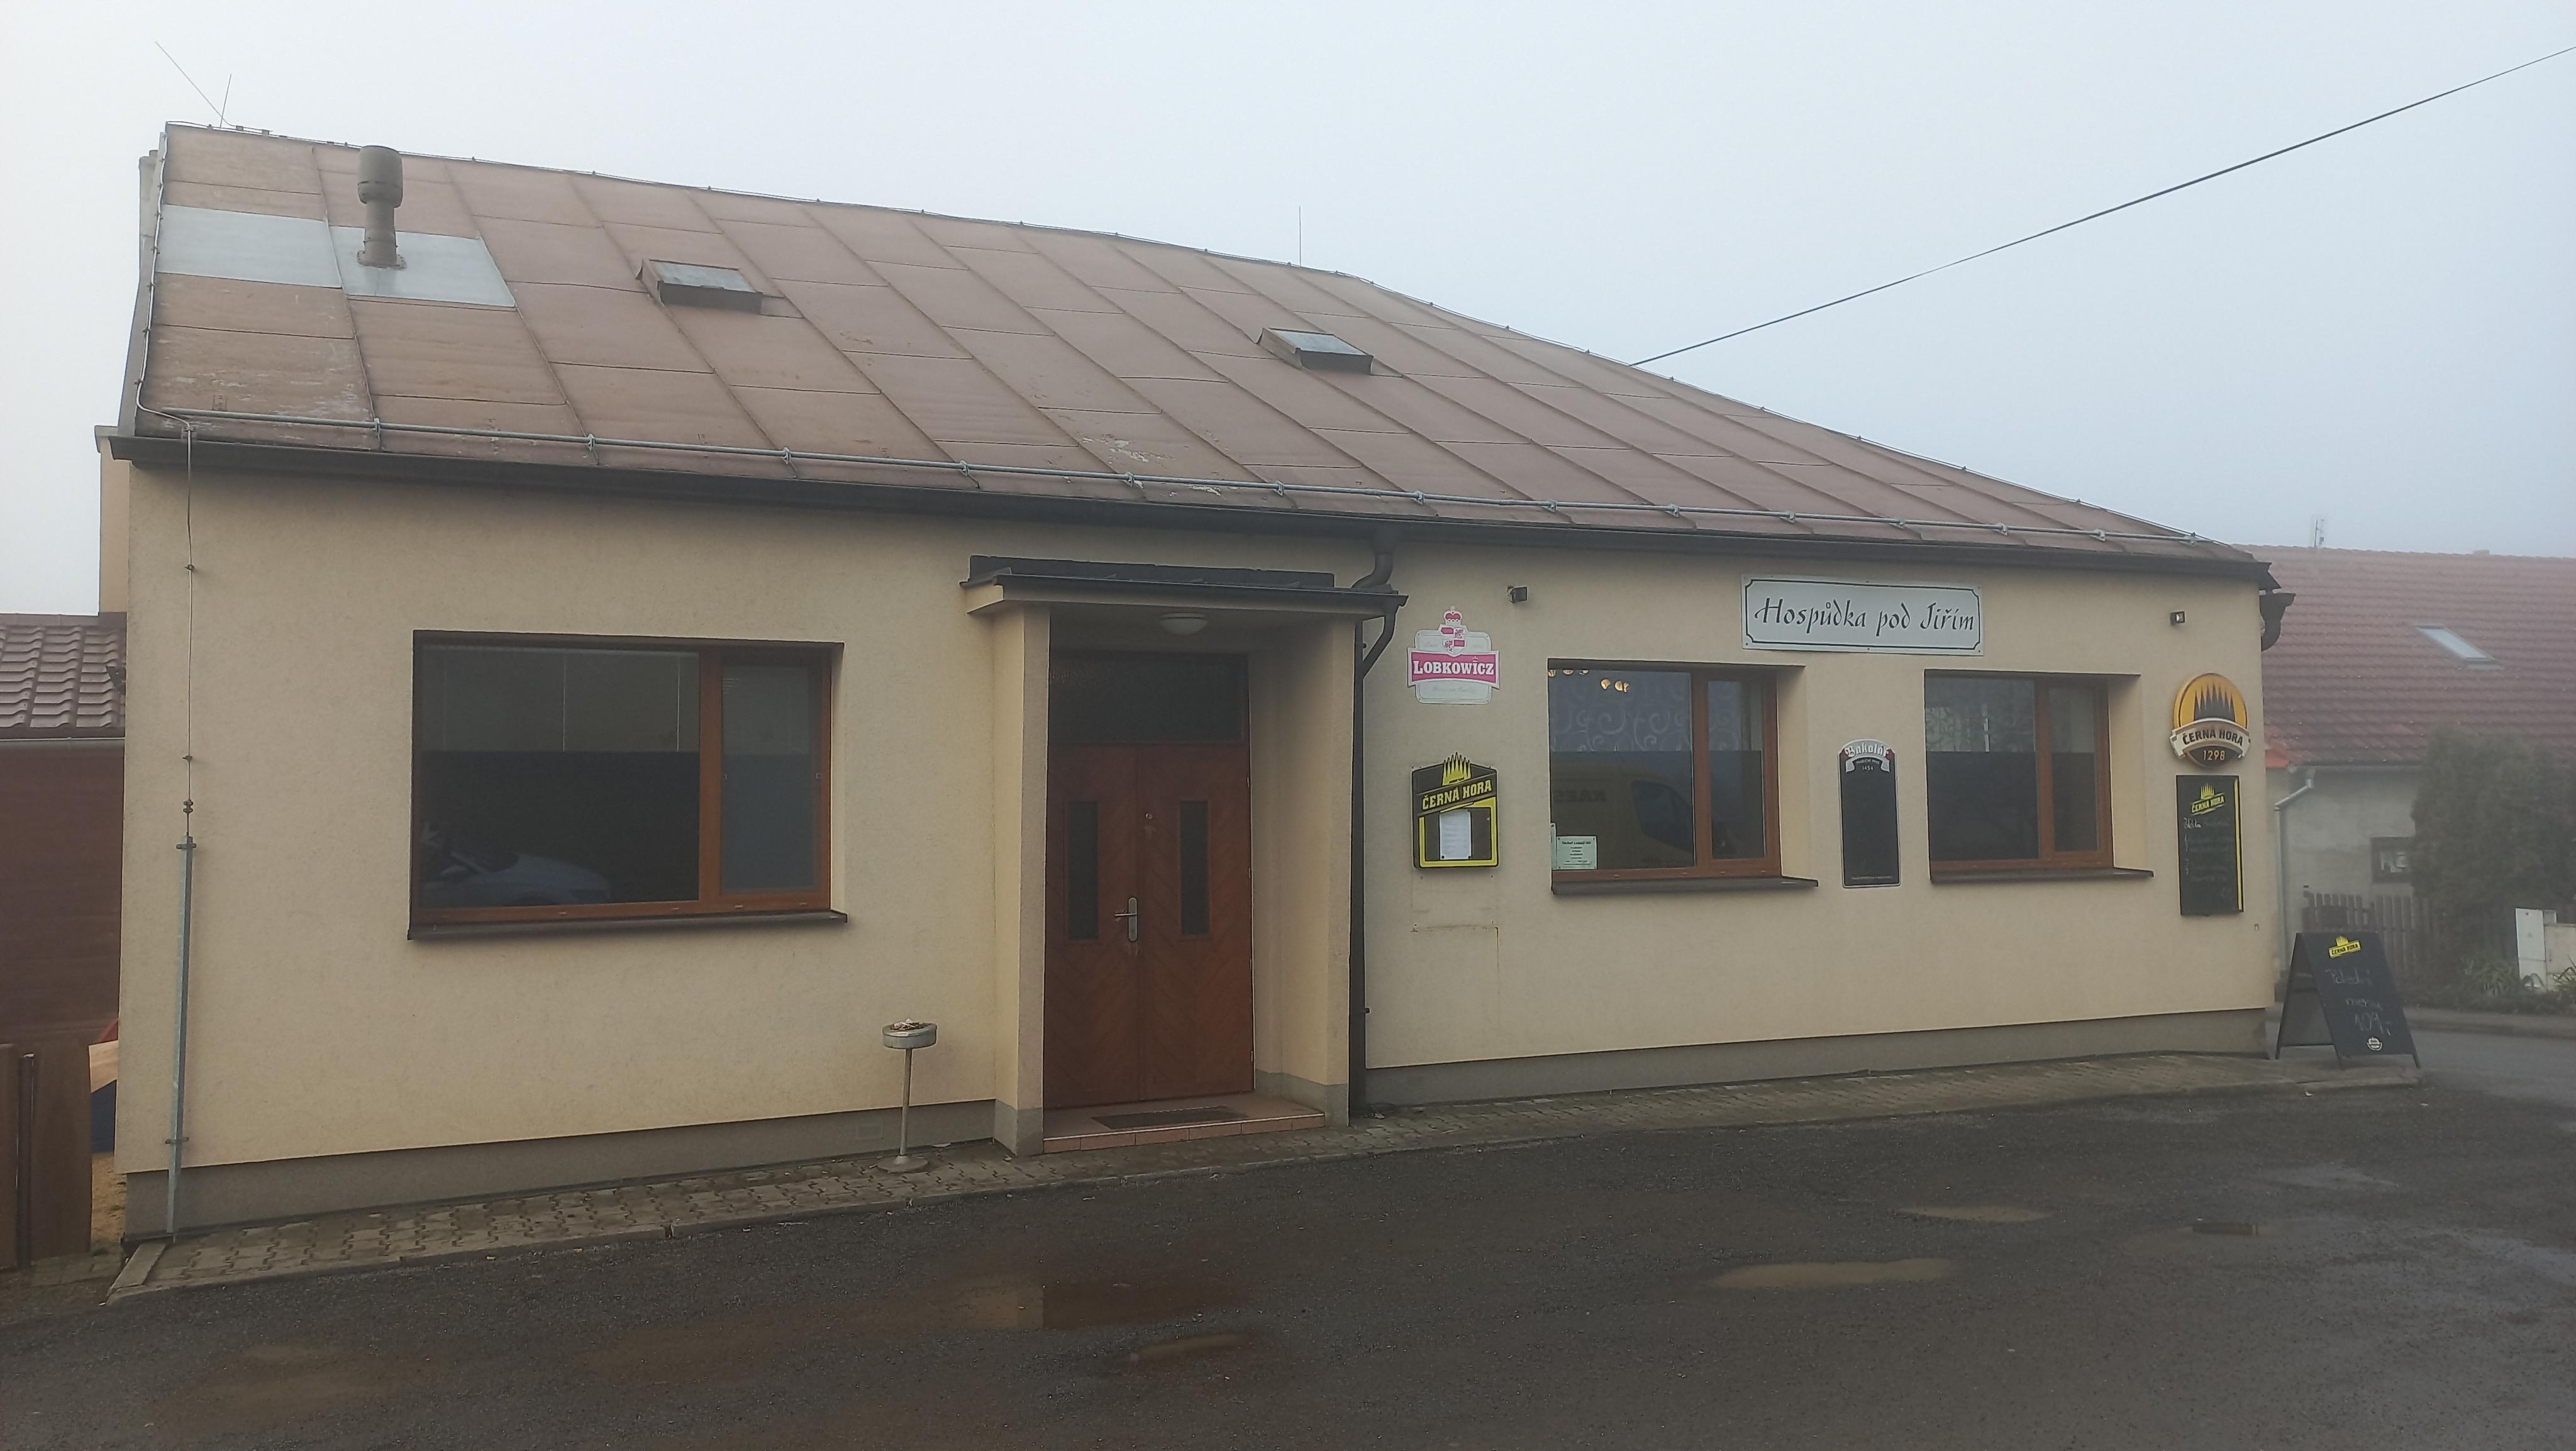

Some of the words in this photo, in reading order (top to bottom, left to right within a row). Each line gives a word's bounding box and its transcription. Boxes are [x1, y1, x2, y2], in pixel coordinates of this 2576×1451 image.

[1754, 598, 1867, 634] Hospůdka
[1875, 602, 1911, 637] pod
[1920, 602, 1975, 630] Jiřím
[1413, 659, 1494, 675] LOBKOWICZ
[2219, 730, 2243, 746] HORA
[2203, 750, 2226, 761] 1298
[1422, 787, 1460, 810] ČERNÁ
[1462, 779, 1492, 799] HORA
